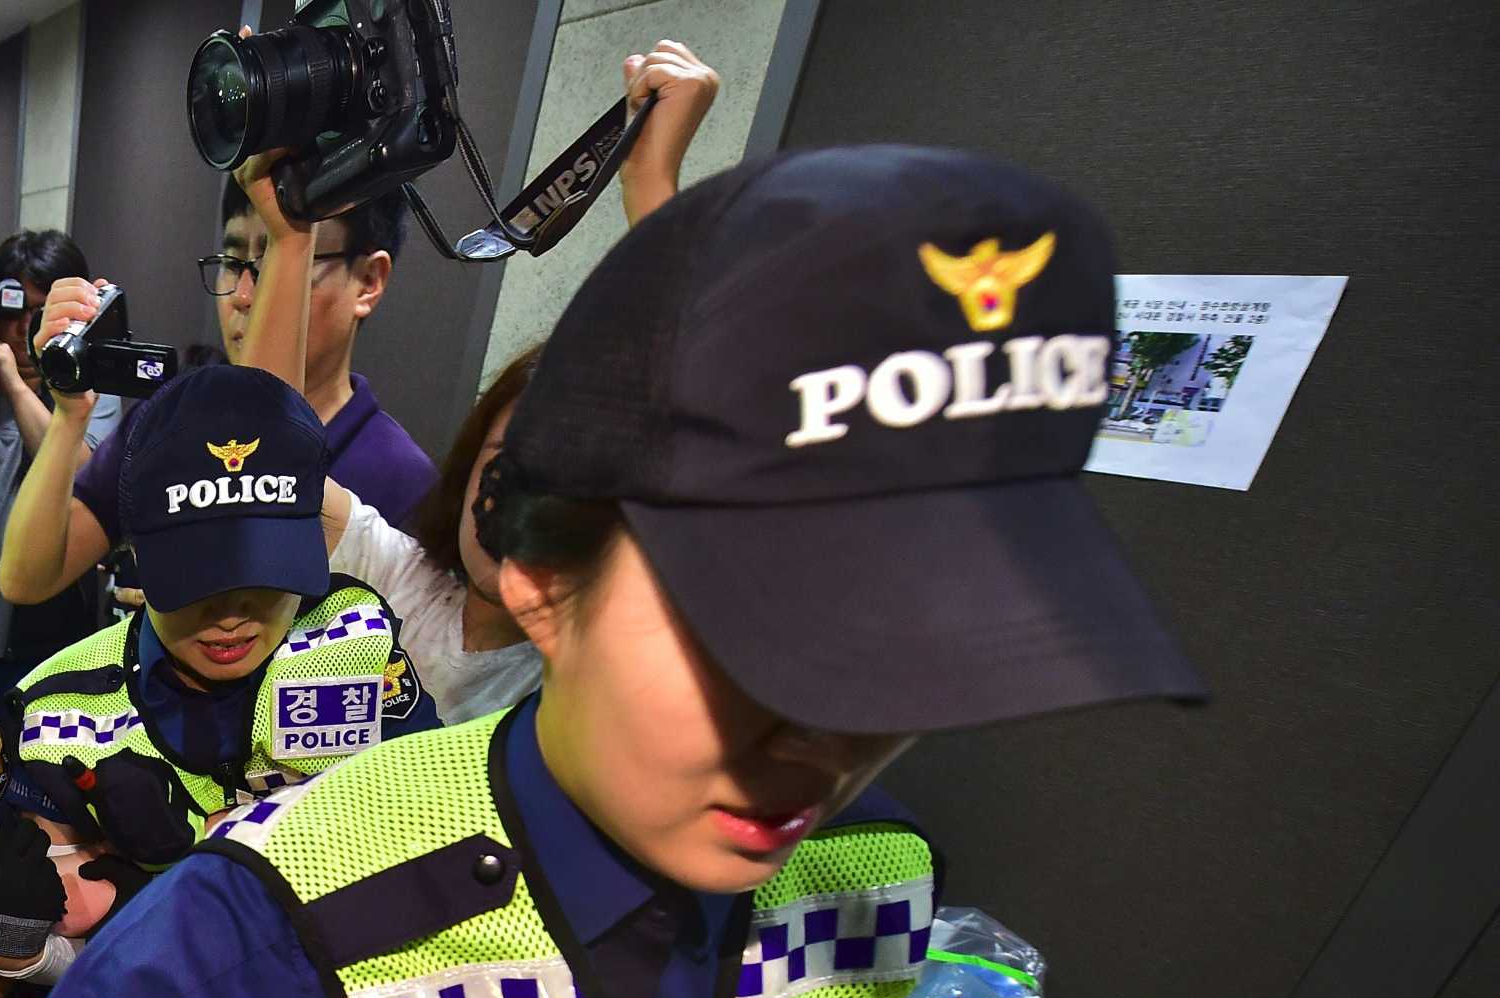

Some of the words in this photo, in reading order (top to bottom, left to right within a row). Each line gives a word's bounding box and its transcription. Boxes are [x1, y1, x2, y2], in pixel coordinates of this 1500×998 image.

[533, 152, 597, 216] NPS
[785, 334, 1109, 448] POLICE
[165, 474, 297, 514] POLICE
[286, 685, 371, 724] 경찰
[284, 728, 370, 750] POLICE
